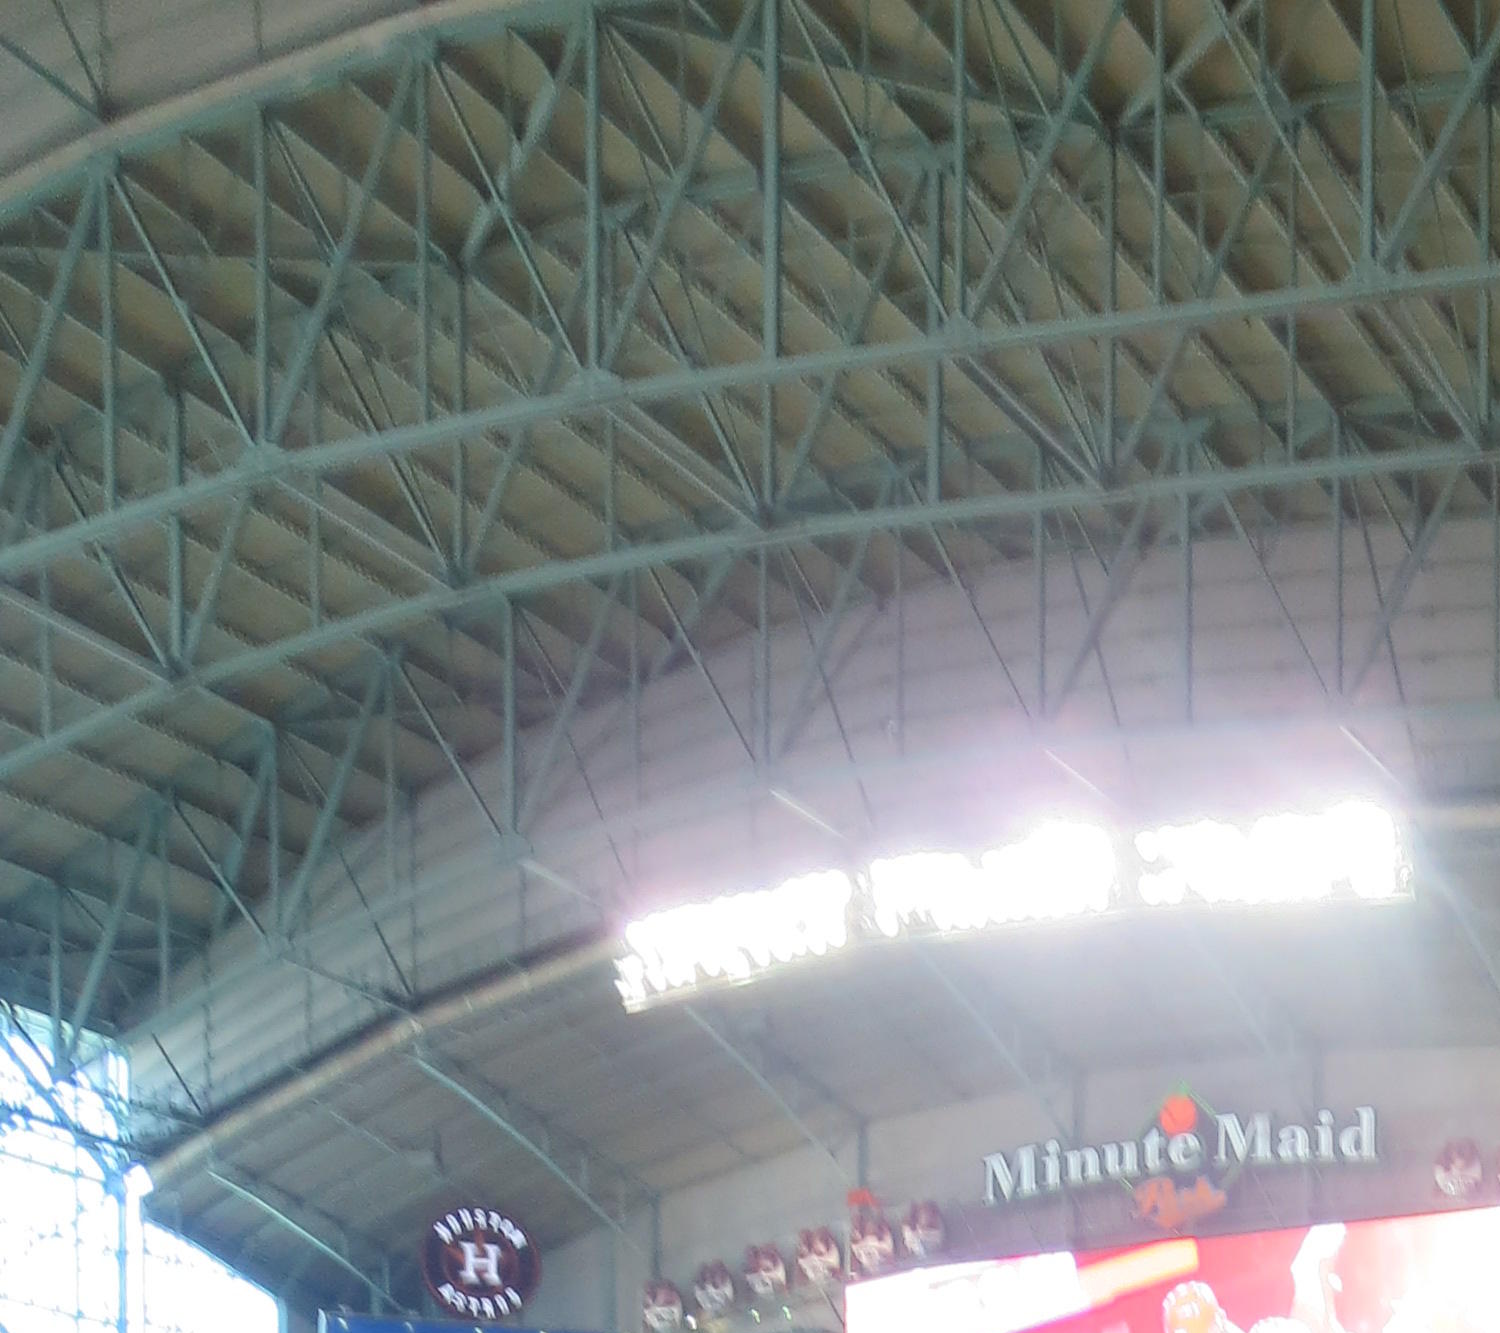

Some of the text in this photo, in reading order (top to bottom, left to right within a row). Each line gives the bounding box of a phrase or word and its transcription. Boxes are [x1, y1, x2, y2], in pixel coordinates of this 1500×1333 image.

[982, 1106, 1379, 1206] Minute Maid
[433, 1208, 528, 1249] HOUSTON
[458, 1242, 503, 1285] H
